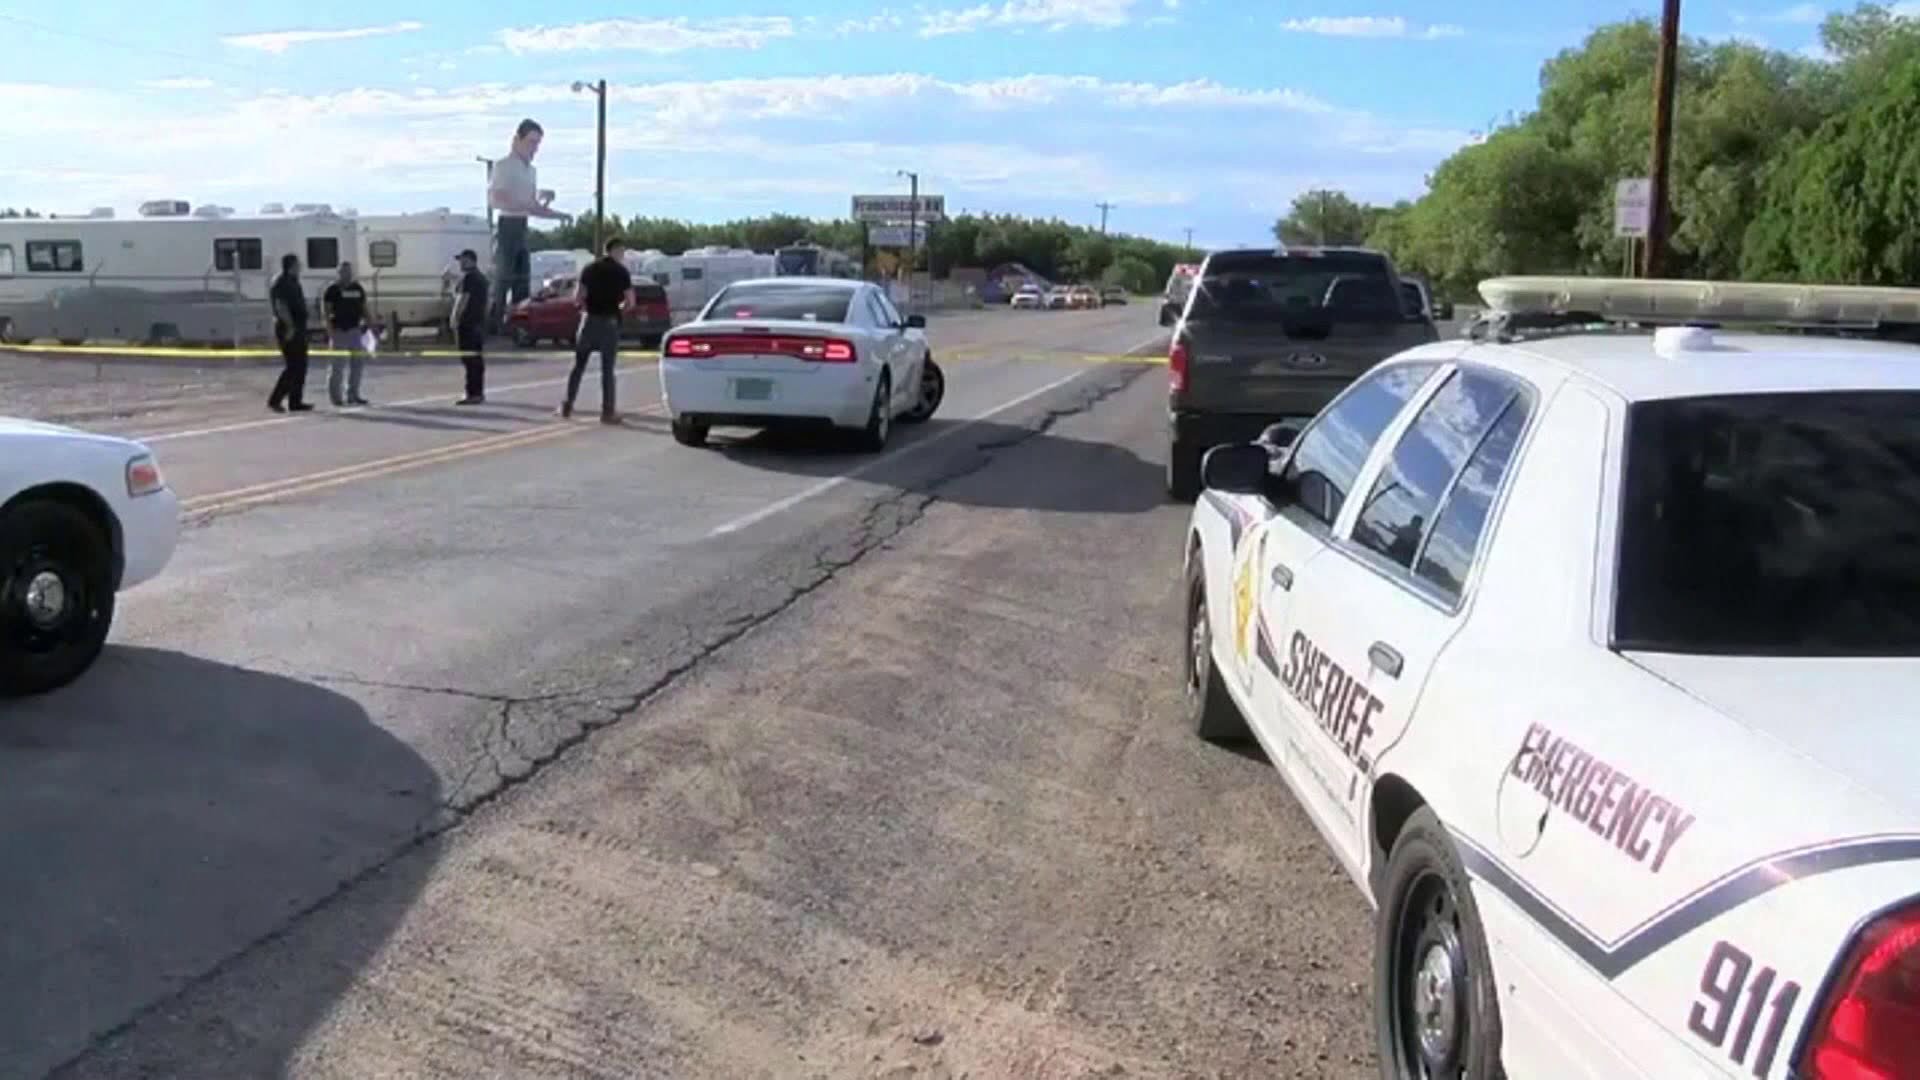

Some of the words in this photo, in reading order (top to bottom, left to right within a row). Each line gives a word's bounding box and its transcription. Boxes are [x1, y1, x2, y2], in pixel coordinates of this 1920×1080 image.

[1281, 629, 1384, 757] SHERIFF
[1510, 721, 1697, 873] EMERGENCY
[1687, 940, 1802, 1080] 911
